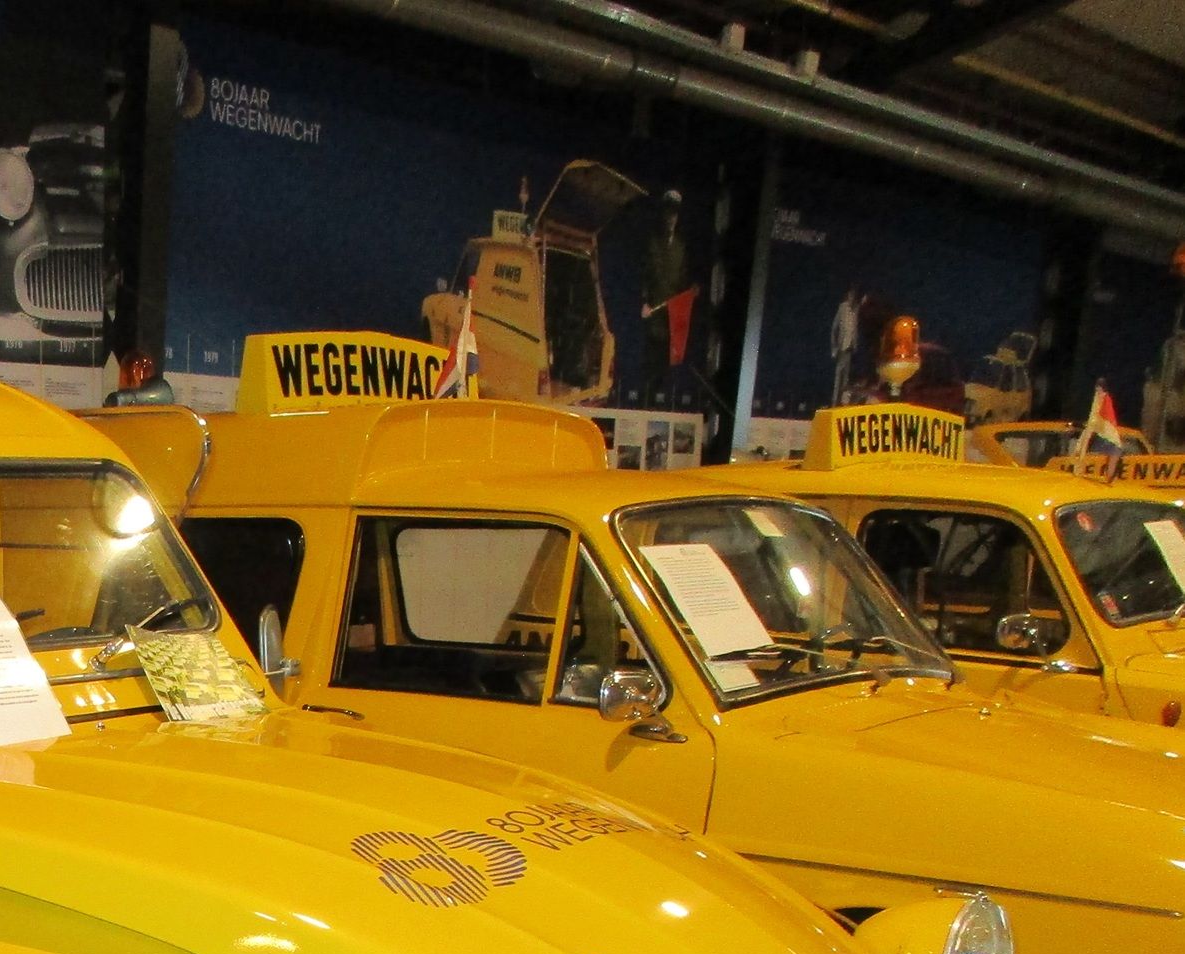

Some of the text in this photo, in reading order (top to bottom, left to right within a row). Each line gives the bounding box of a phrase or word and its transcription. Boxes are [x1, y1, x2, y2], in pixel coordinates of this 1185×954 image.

[209, 100, 322, 144] WEGENWACHT
[272, 342, 471, 400] WEGENWAC
[836, 413, 962, 460] WEGENWACHT
